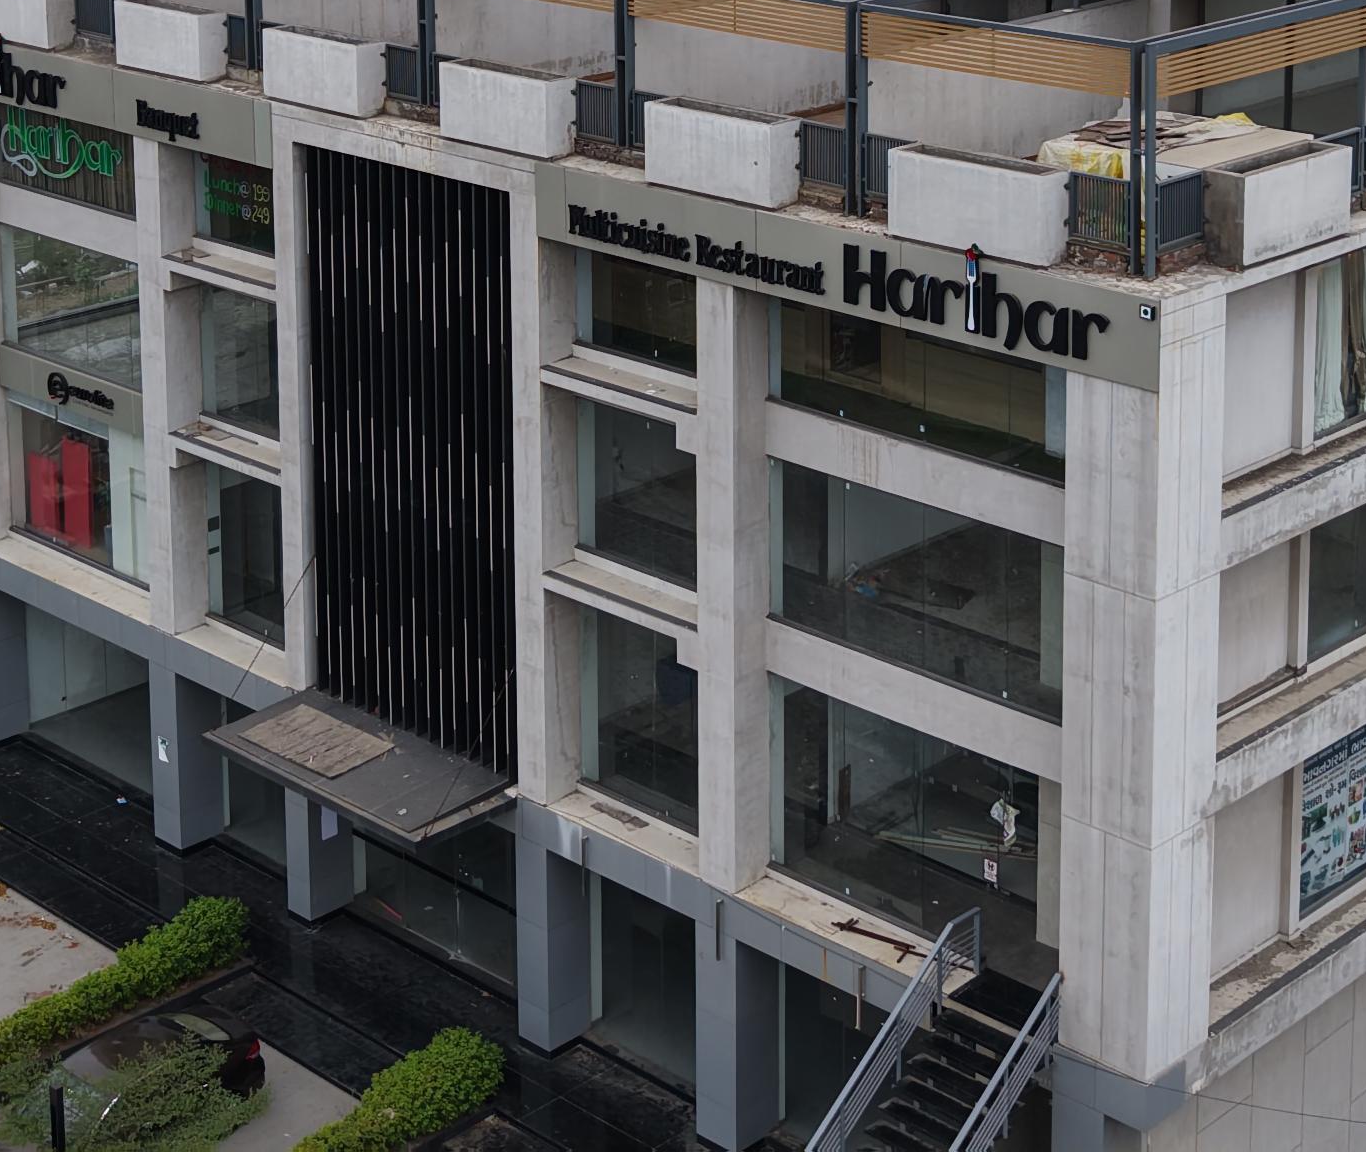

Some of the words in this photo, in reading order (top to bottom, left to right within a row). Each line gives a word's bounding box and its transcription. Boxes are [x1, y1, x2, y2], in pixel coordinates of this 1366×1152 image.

[0, 104, 123, 179] Harihar
[568, 204, 691, 263] Multicuisine
[695, 234, 826, 296] Restaurant
[843, 244, 1110, 360] Harihar
